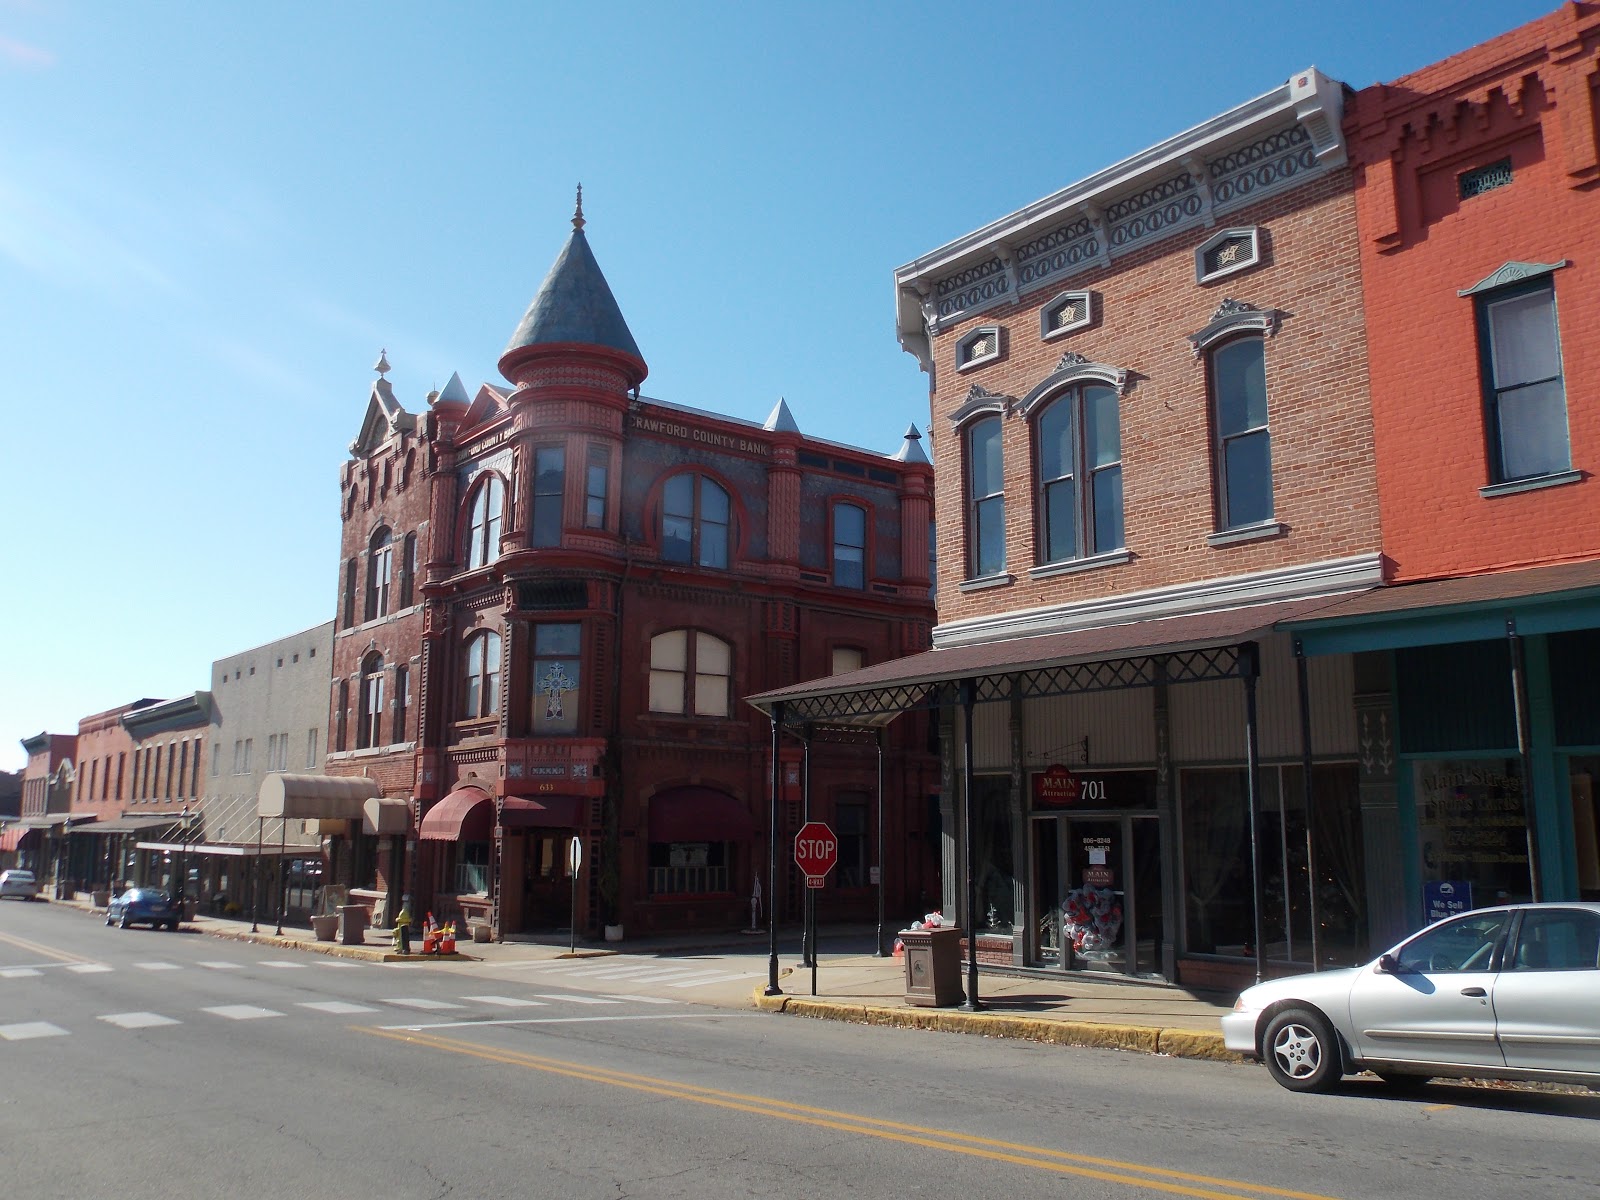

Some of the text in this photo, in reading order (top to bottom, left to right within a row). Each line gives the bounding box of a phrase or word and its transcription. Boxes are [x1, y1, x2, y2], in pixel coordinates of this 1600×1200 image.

[693, 429, 735, 448] COUNTY
[740, 440, 767, 455] BANK
[539, 783, 554, 792] 633
[1042, 777, 1075, 789] MAIN
[1042, 789, 1076, 797] Attraction
[1081, 780, 1107, 800] 701
[798, 839, 834, 859] STOP
[1432, 899, 1463, 909] We Sell
